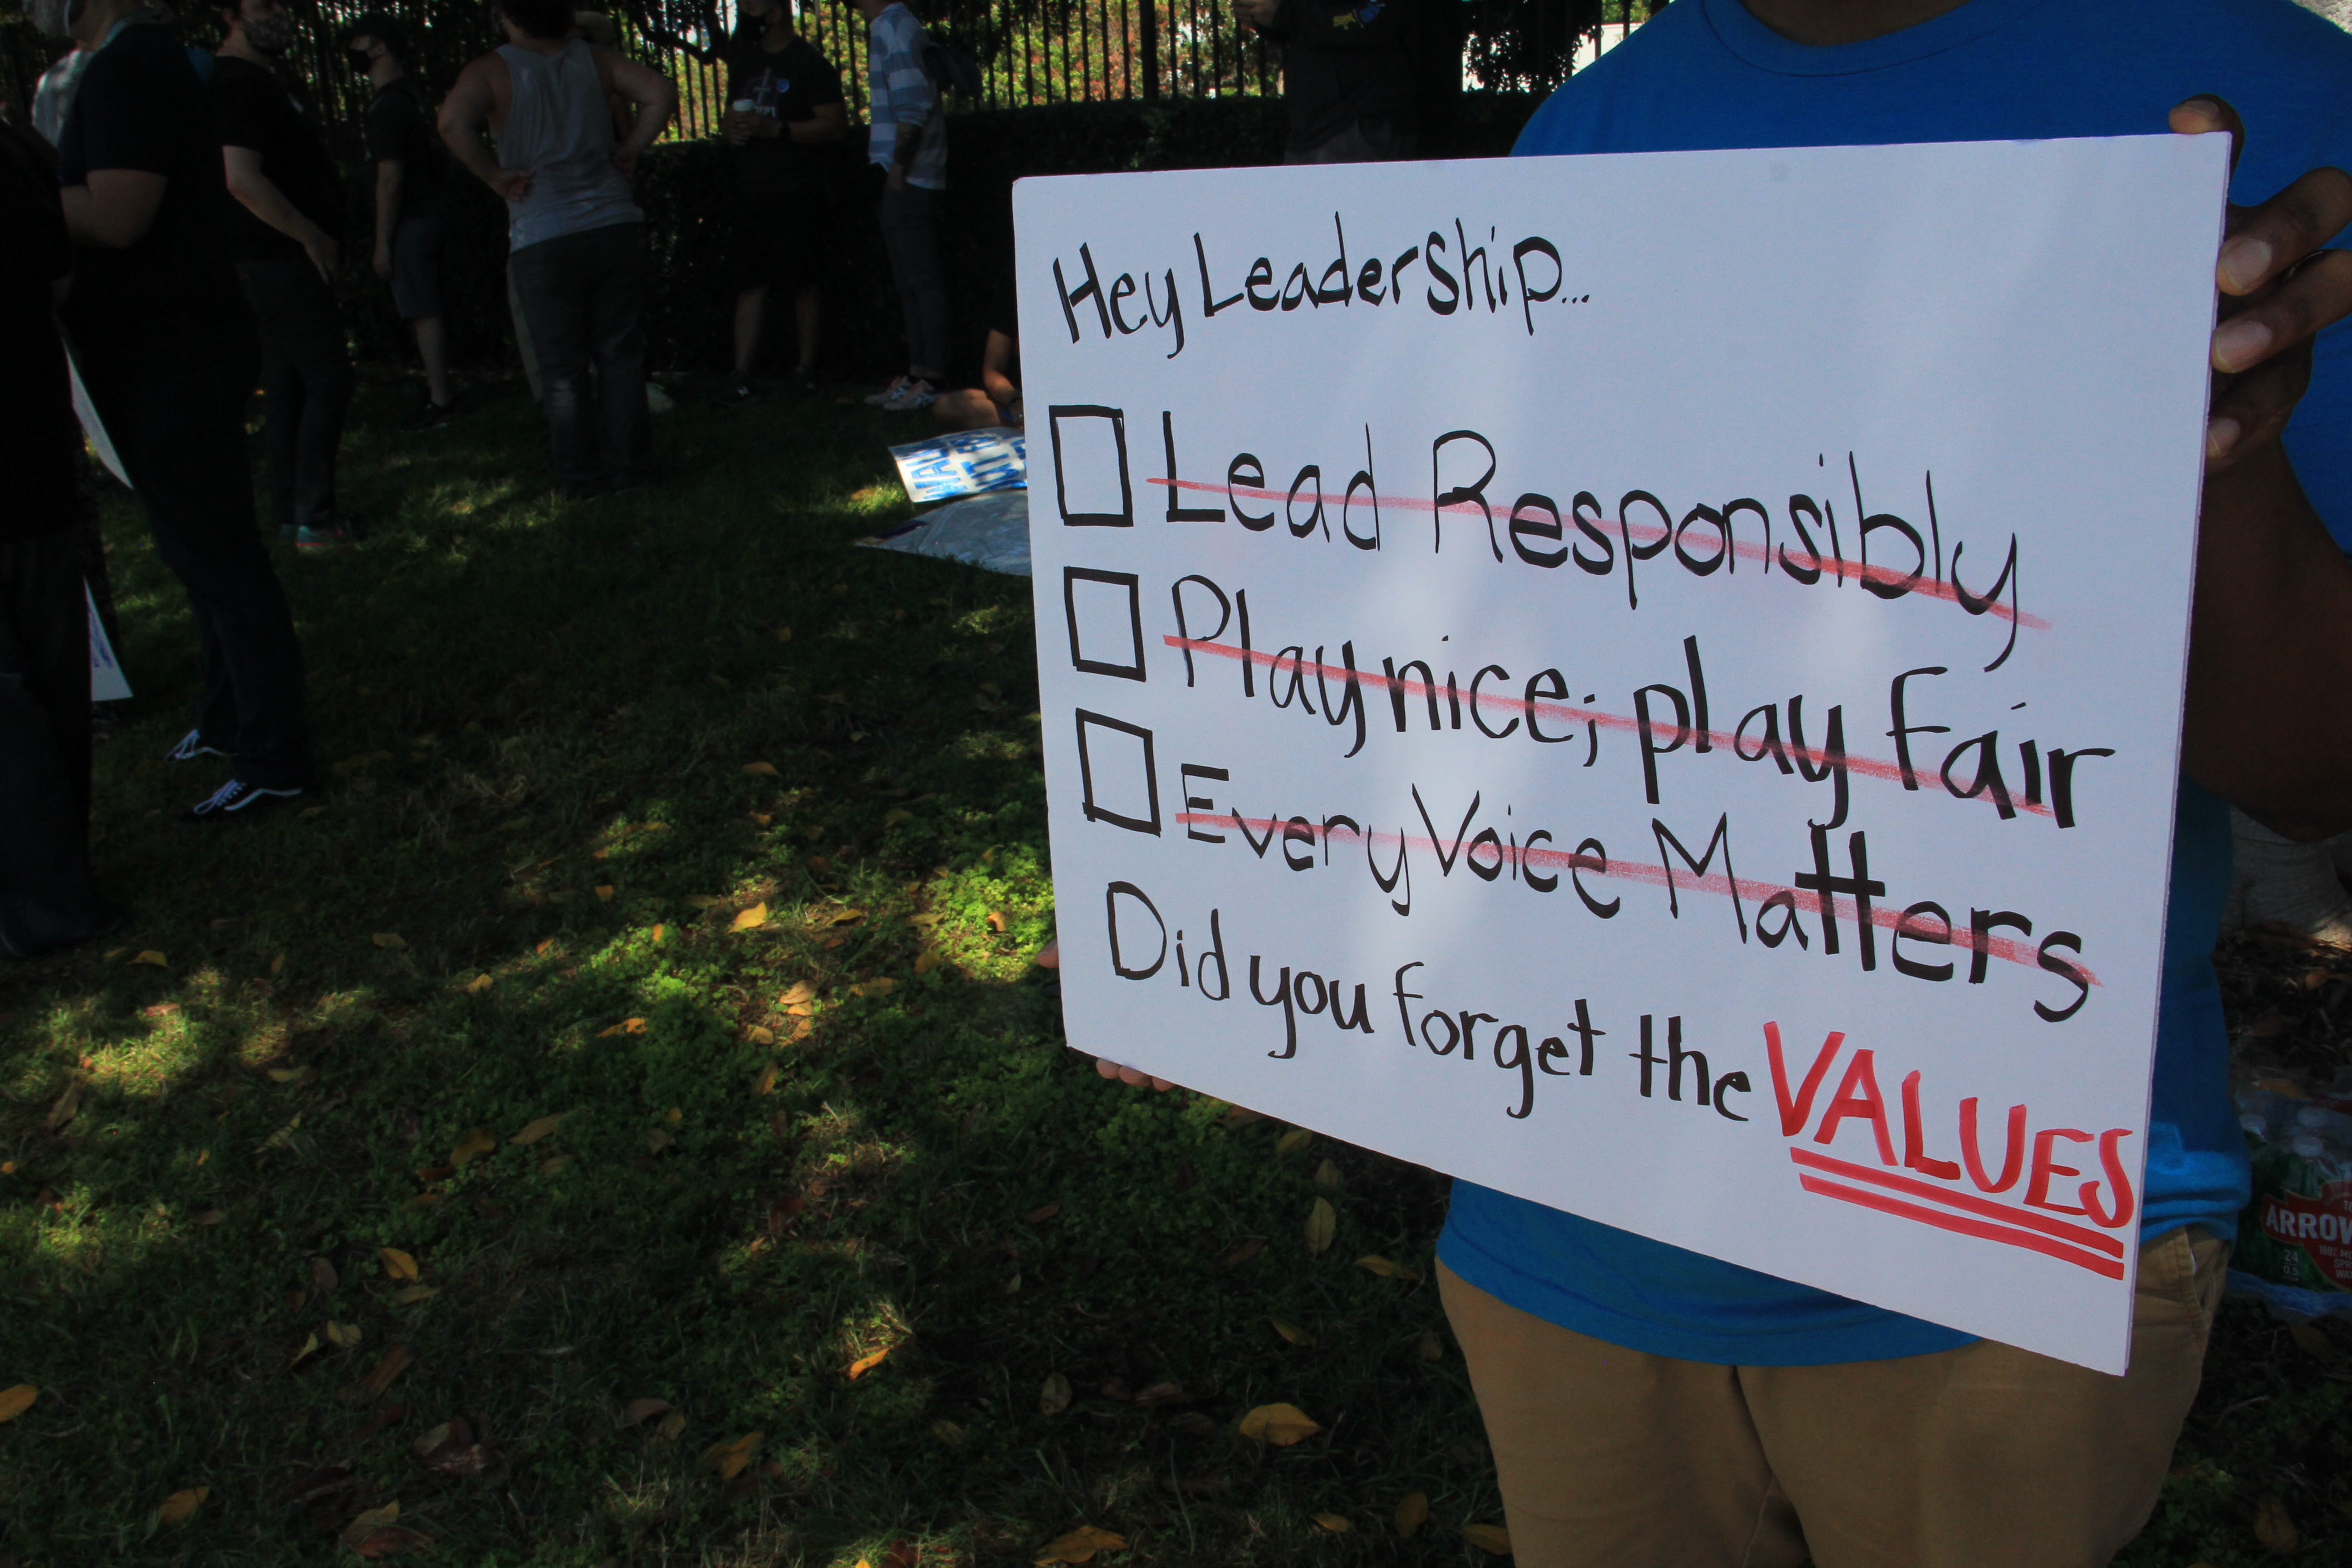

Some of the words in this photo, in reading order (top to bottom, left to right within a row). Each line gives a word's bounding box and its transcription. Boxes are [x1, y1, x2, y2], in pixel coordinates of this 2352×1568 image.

[1054, 243, 1184, 359] Hey
[1163, 412, 1380, 551] Lead
[1433, 431, 2017, 672] Responsibly
[1172, 575, 1366, 758] Play
[1383, 636, 1597, 767] nice;
[1633, 635, 1845, 829] play
[1181, 764, 1410, 916] Every
[1412, 784, 1620, 919] Voice
[1652, 813, 2088, 1022] Matters
[1107, 881, 1229, 1000] Did
[1250, 956, 1374, 1058] you
[1393, 962, 1606, 1118] forget
[1629, 1014, 1751, 1121] the
[1764, 1021, 2134, 1228] VALUES
[2284, 1249, 2299, 1263] 24
